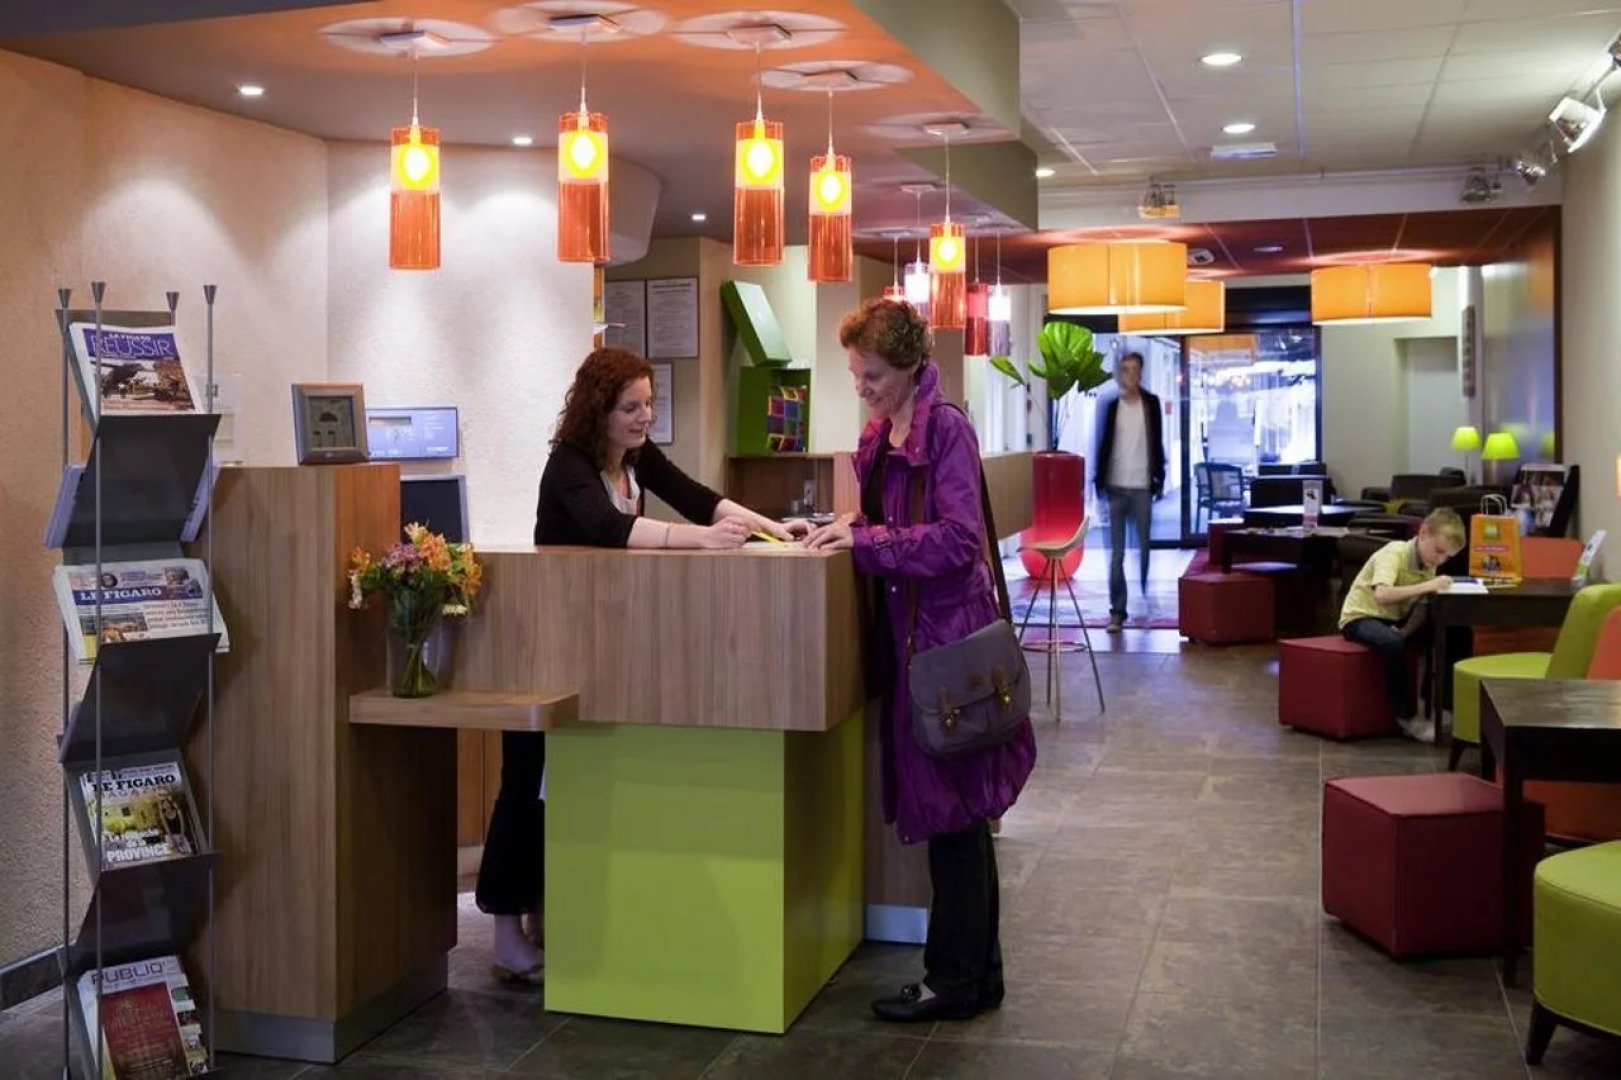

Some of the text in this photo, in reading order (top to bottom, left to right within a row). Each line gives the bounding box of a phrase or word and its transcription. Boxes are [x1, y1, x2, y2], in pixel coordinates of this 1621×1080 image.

[104, 587, 162, 600] FIGARO
[116, 773, 176, 790] FIGARO
[106, 842, 169, 862] PROVINCE
